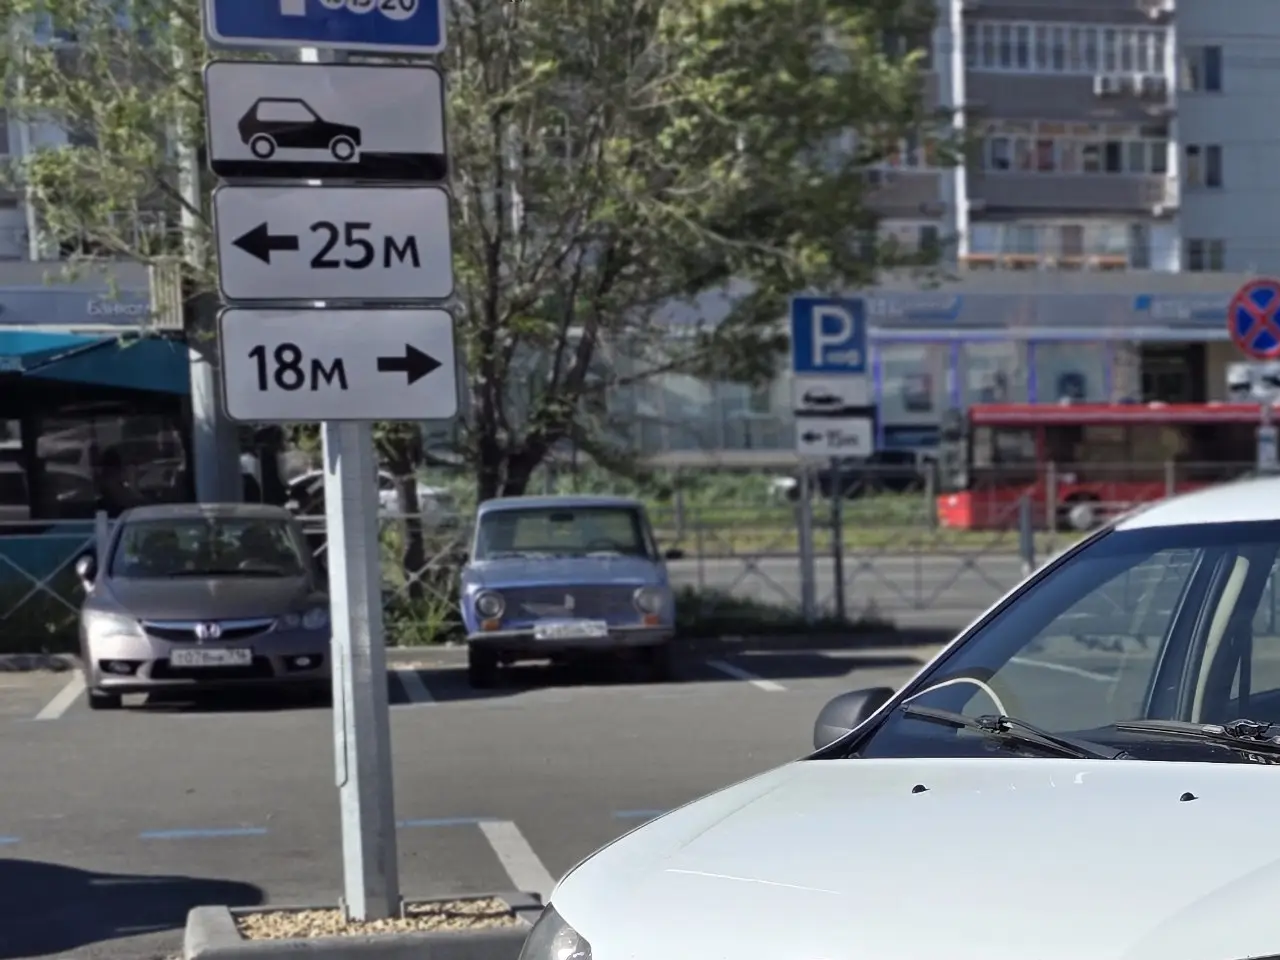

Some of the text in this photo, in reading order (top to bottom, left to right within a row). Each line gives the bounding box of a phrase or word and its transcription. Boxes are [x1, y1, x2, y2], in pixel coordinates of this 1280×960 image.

[309, 221, 421, 270] 25м
[811, 304, 854, 367] P
[248, 342, 349, 392] 18м
